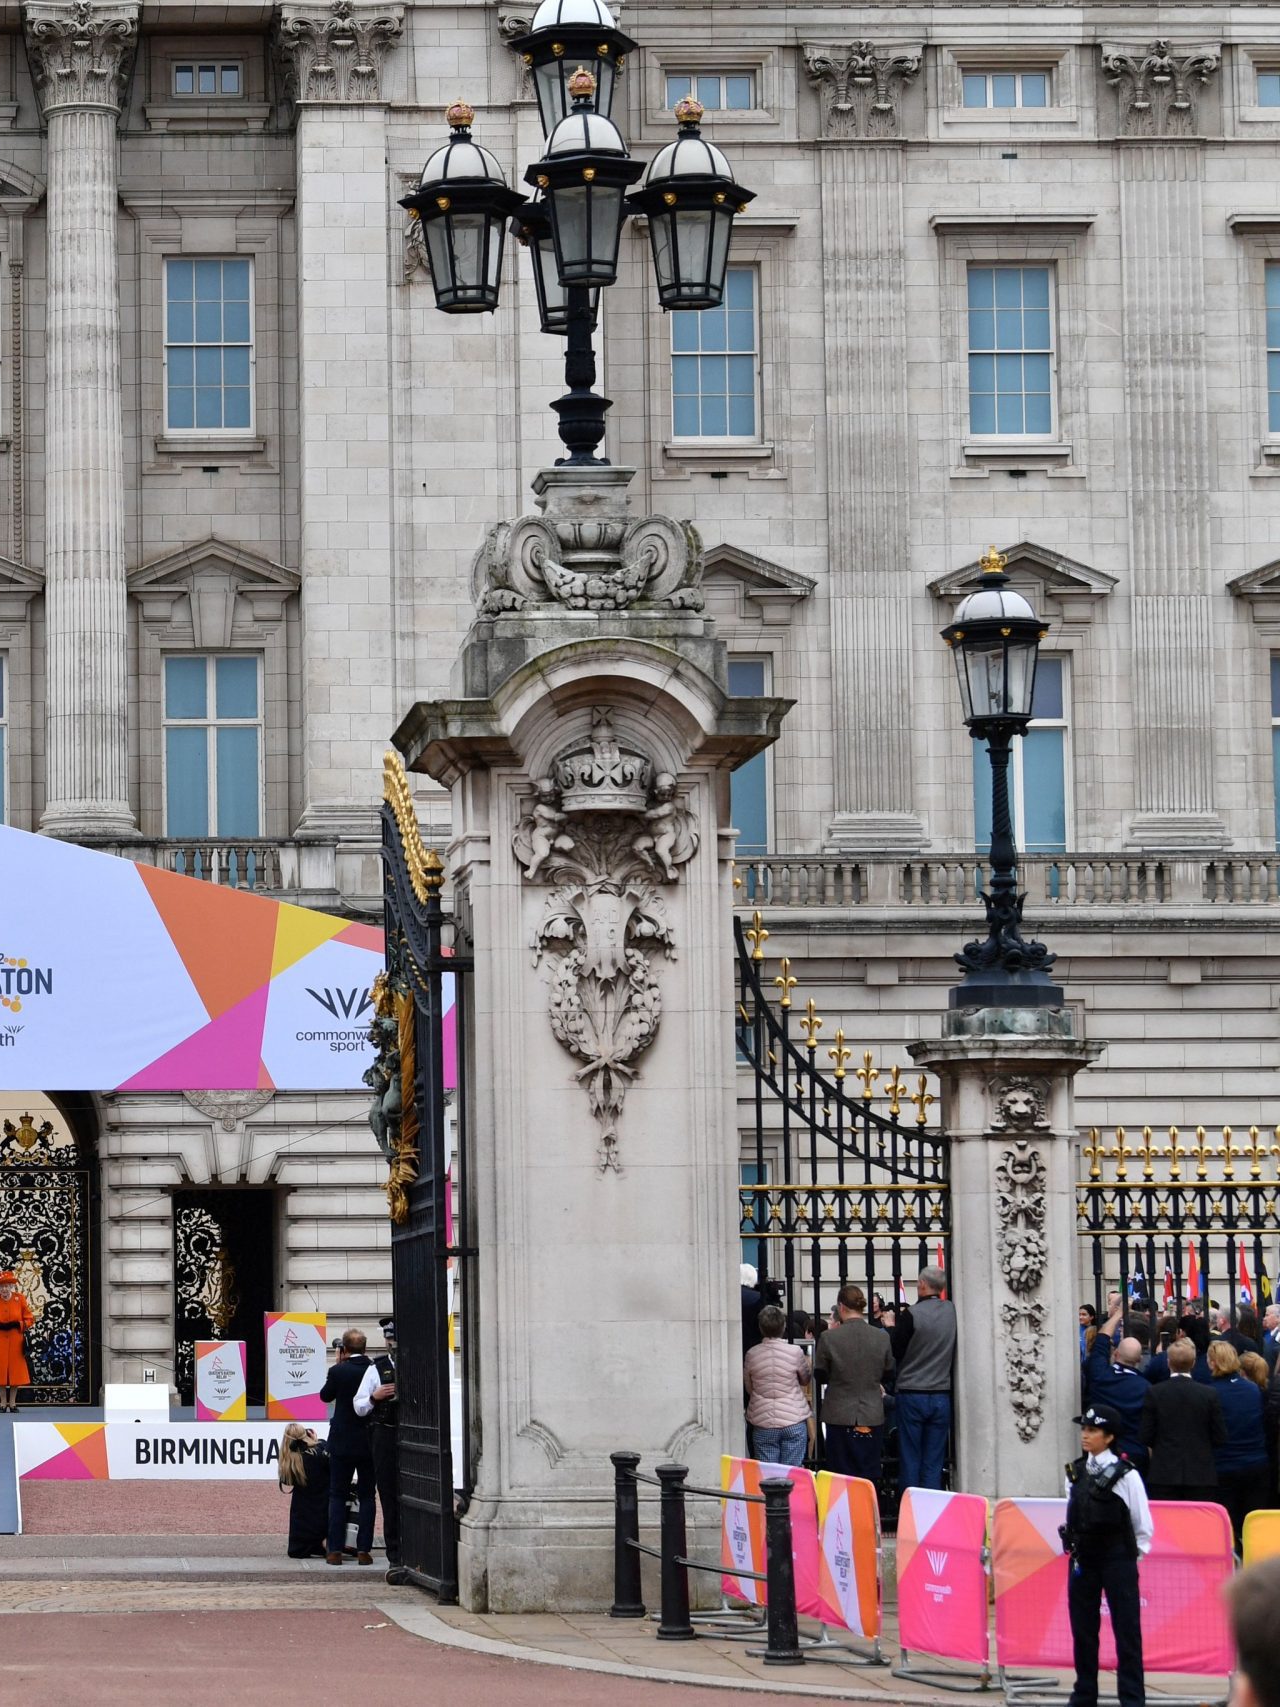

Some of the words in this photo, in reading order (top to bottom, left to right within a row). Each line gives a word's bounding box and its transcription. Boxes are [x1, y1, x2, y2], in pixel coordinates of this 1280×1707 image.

[296, 1031, 367, 1041] commonw
[330, 1041, 365, 1053] sport
[135, 1438, 279, 1464] BIRMINGHA
